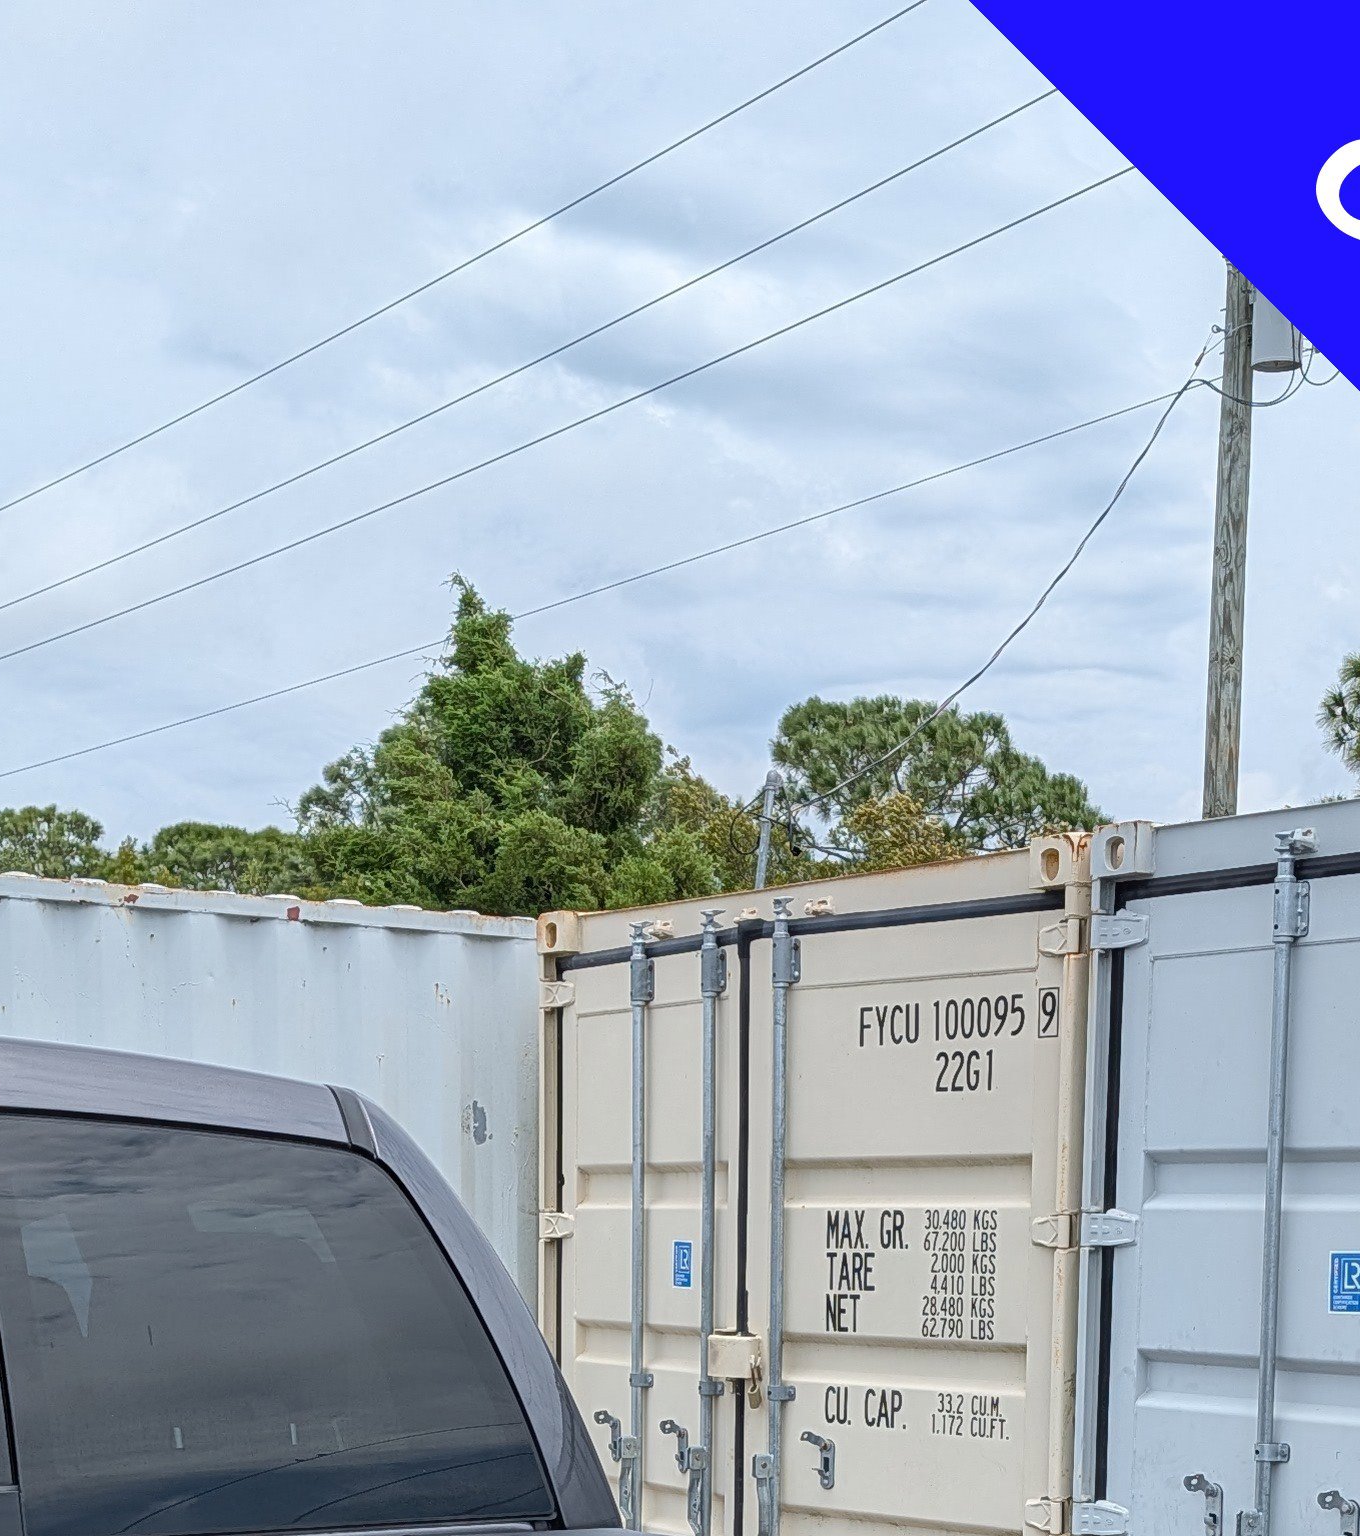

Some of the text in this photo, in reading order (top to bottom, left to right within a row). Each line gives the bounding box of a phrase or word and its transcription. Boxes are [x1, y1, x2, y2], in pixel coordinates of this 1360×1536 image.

[859, 990, 1058, 1048] FYCU 100095 9
[935, 1048, 994, 1093] 22G1
[826, 1209, 909, 1250] MAX. GR.
[924, 1209, 998, 1231] 30,480 KGS
[972, 1231, 997, 1253] LBS
[826, 1252, 876, 1292] TARE
[971, 1253, 996, 1275] KGS
[971, 1275, 996, 1297] LBS
[825, 1293, 861, 1333] NET
[970, 1297, 995, 1319] KGS
[921, 1317, 995, 1341] 62,790 LBS
[824, 1385, 907, 1430] CU. CAP.
[937, 1392, 1003, 1418] 33.2 CU.M.
[970, 1416, 1010, 1441] CU.FT.
